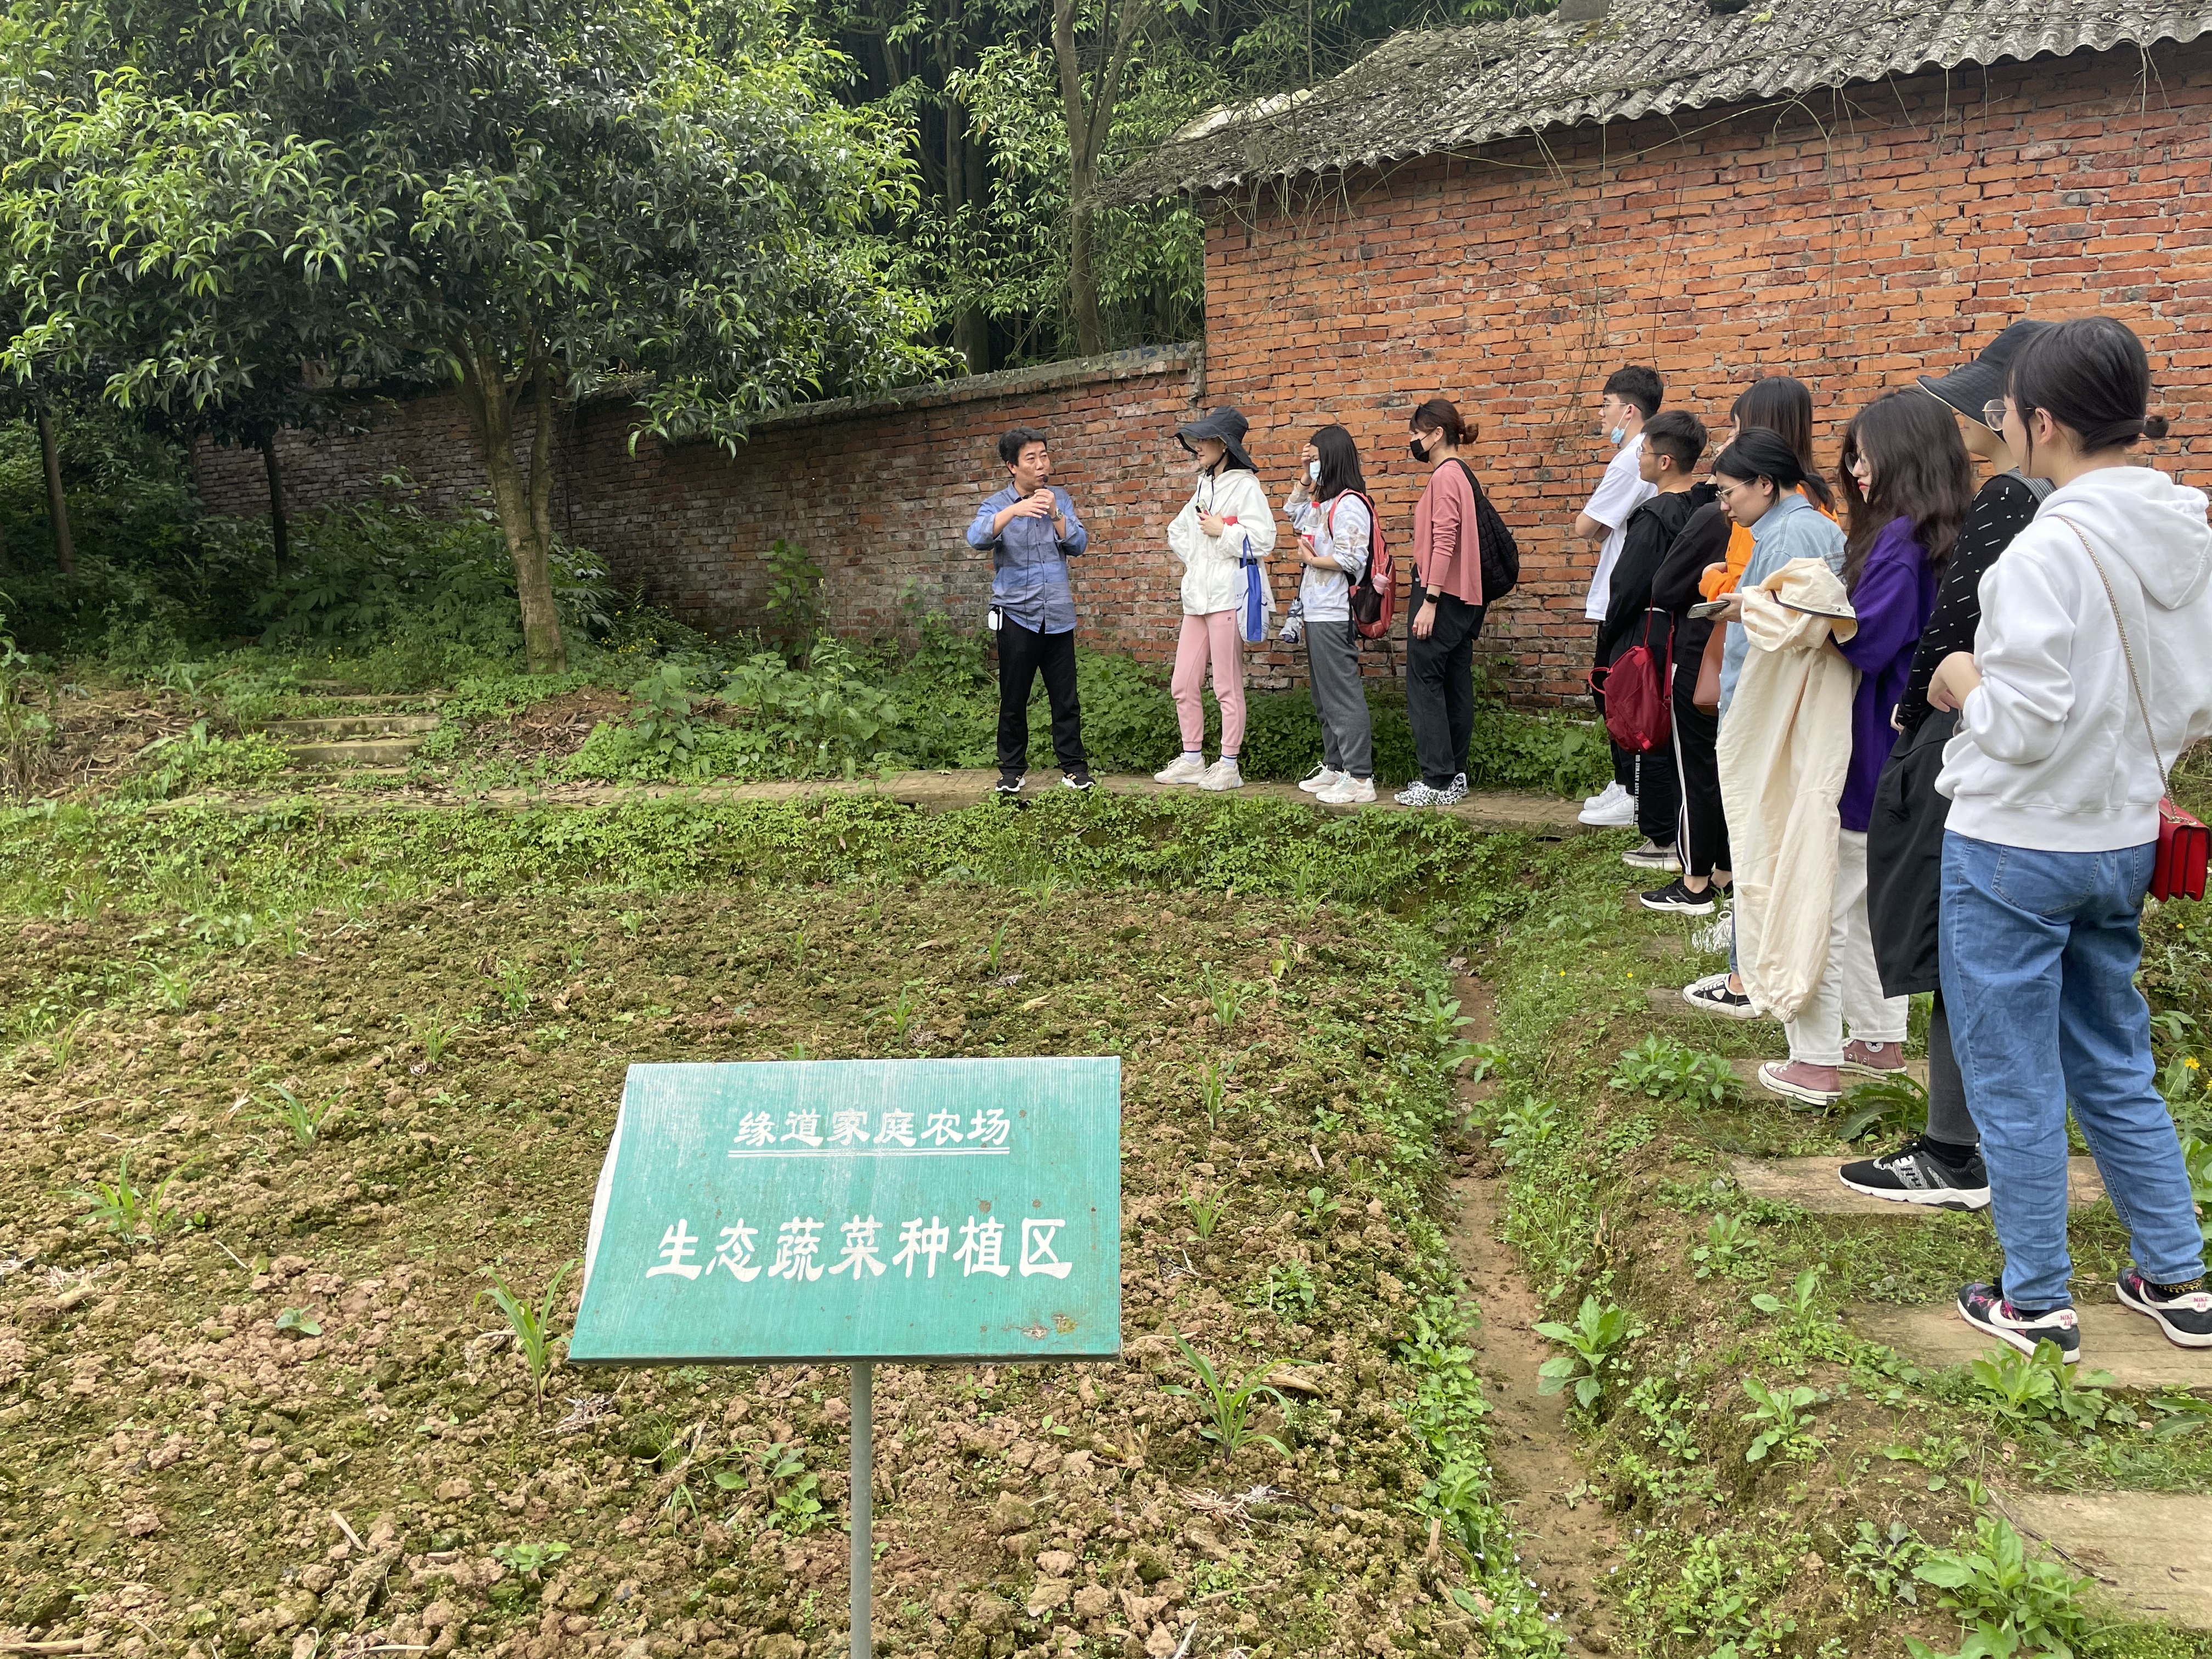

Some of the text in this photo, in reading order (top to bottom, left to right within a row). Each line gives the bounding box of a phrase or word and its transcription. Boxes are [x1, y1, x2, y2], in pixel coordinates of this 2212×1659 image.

[733, 1108, 1010, 1147] 缘道家庭农场
[646, 1214, 1073, 1282] 生态蔬菜种植区
